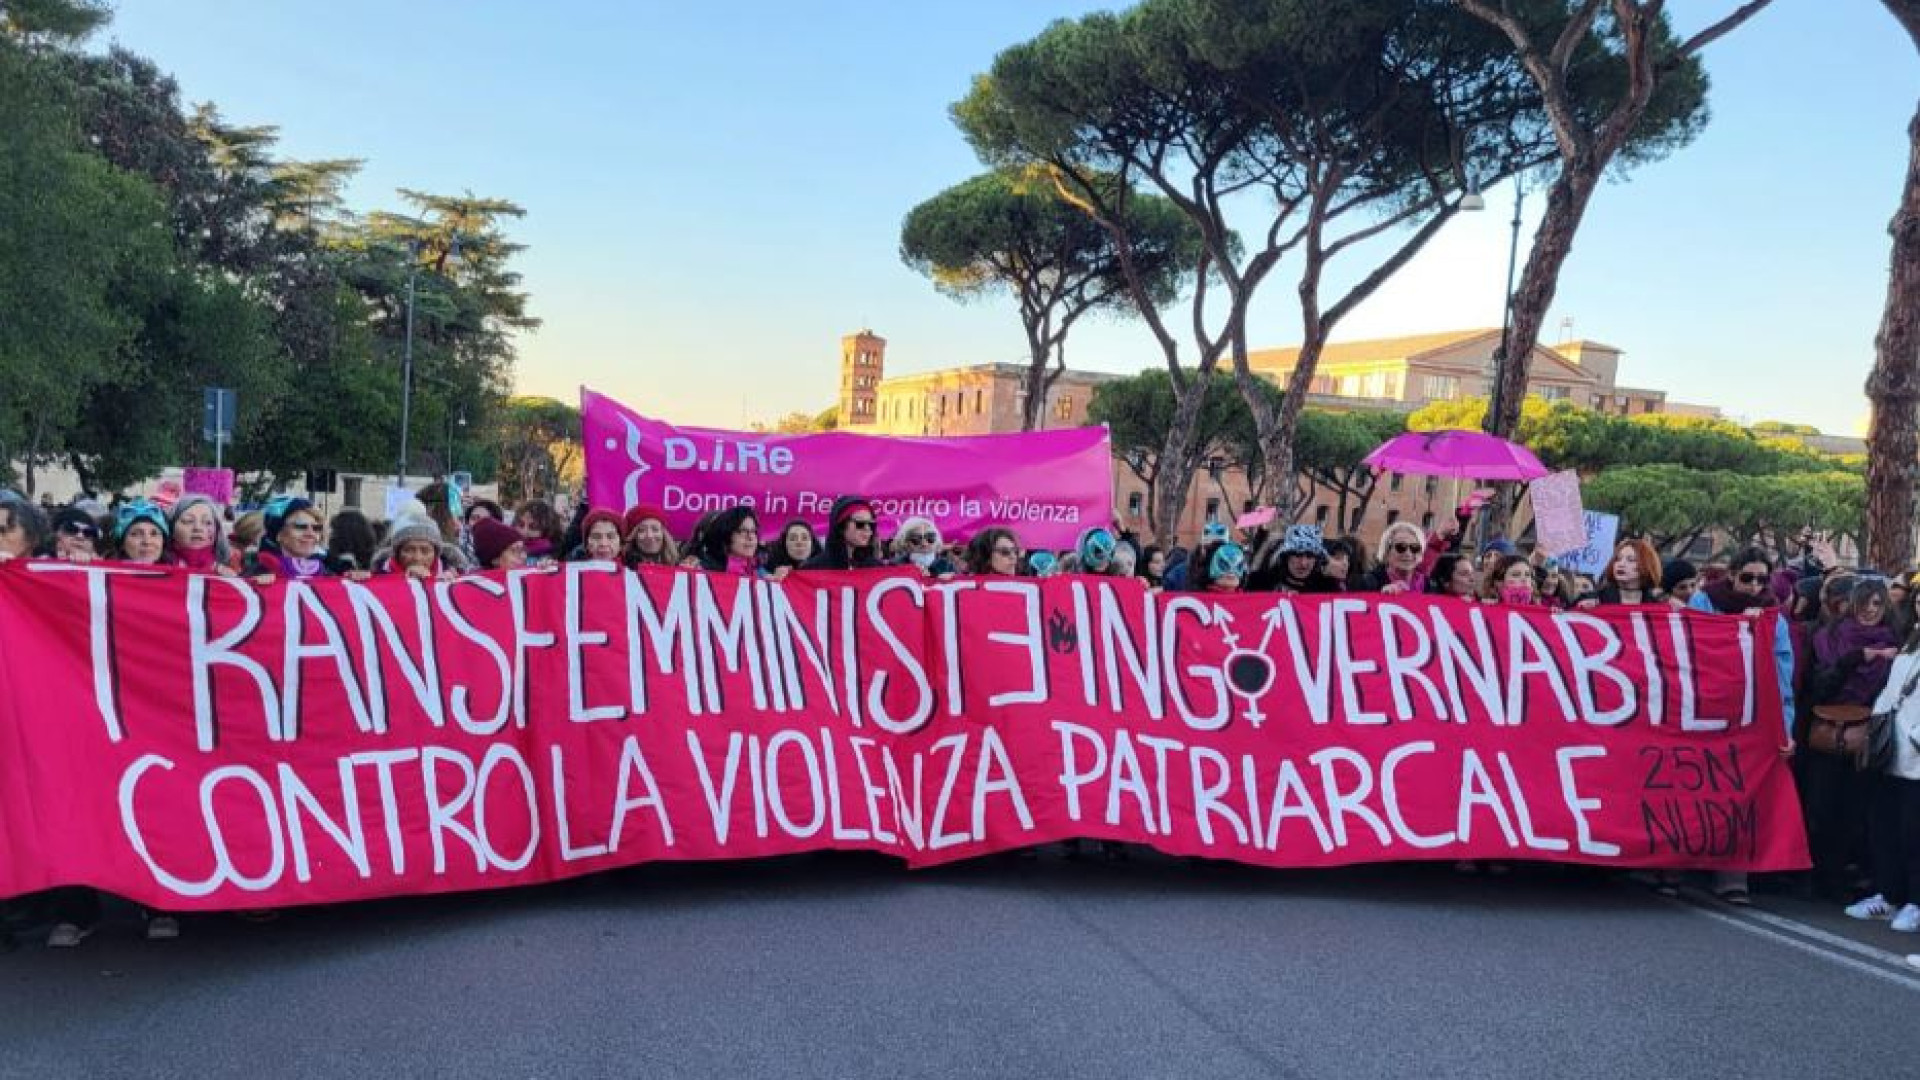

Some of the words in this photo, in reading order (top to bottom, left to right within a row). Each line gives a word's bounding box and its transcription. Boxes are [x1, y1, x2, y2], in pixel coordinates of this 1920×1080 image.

[663, 437, 793, 475] D.i.Re
[765, 491, 788, 513] in
[870, 496, 949, 517] contro
[960, 495, 980, 518] la
[989, 497, 1079, 524] violenza
[1640, 742, 1745, 792] 25N
[119, 743, 540, 896] CONTRO
[551, 735, 673, 861] LA
[687, 727, 1034, 851] VIOLENZA
[1051, 720, 1620, 856] PATRIARCALE
[1640, 796, 1757, 864] NUDM
